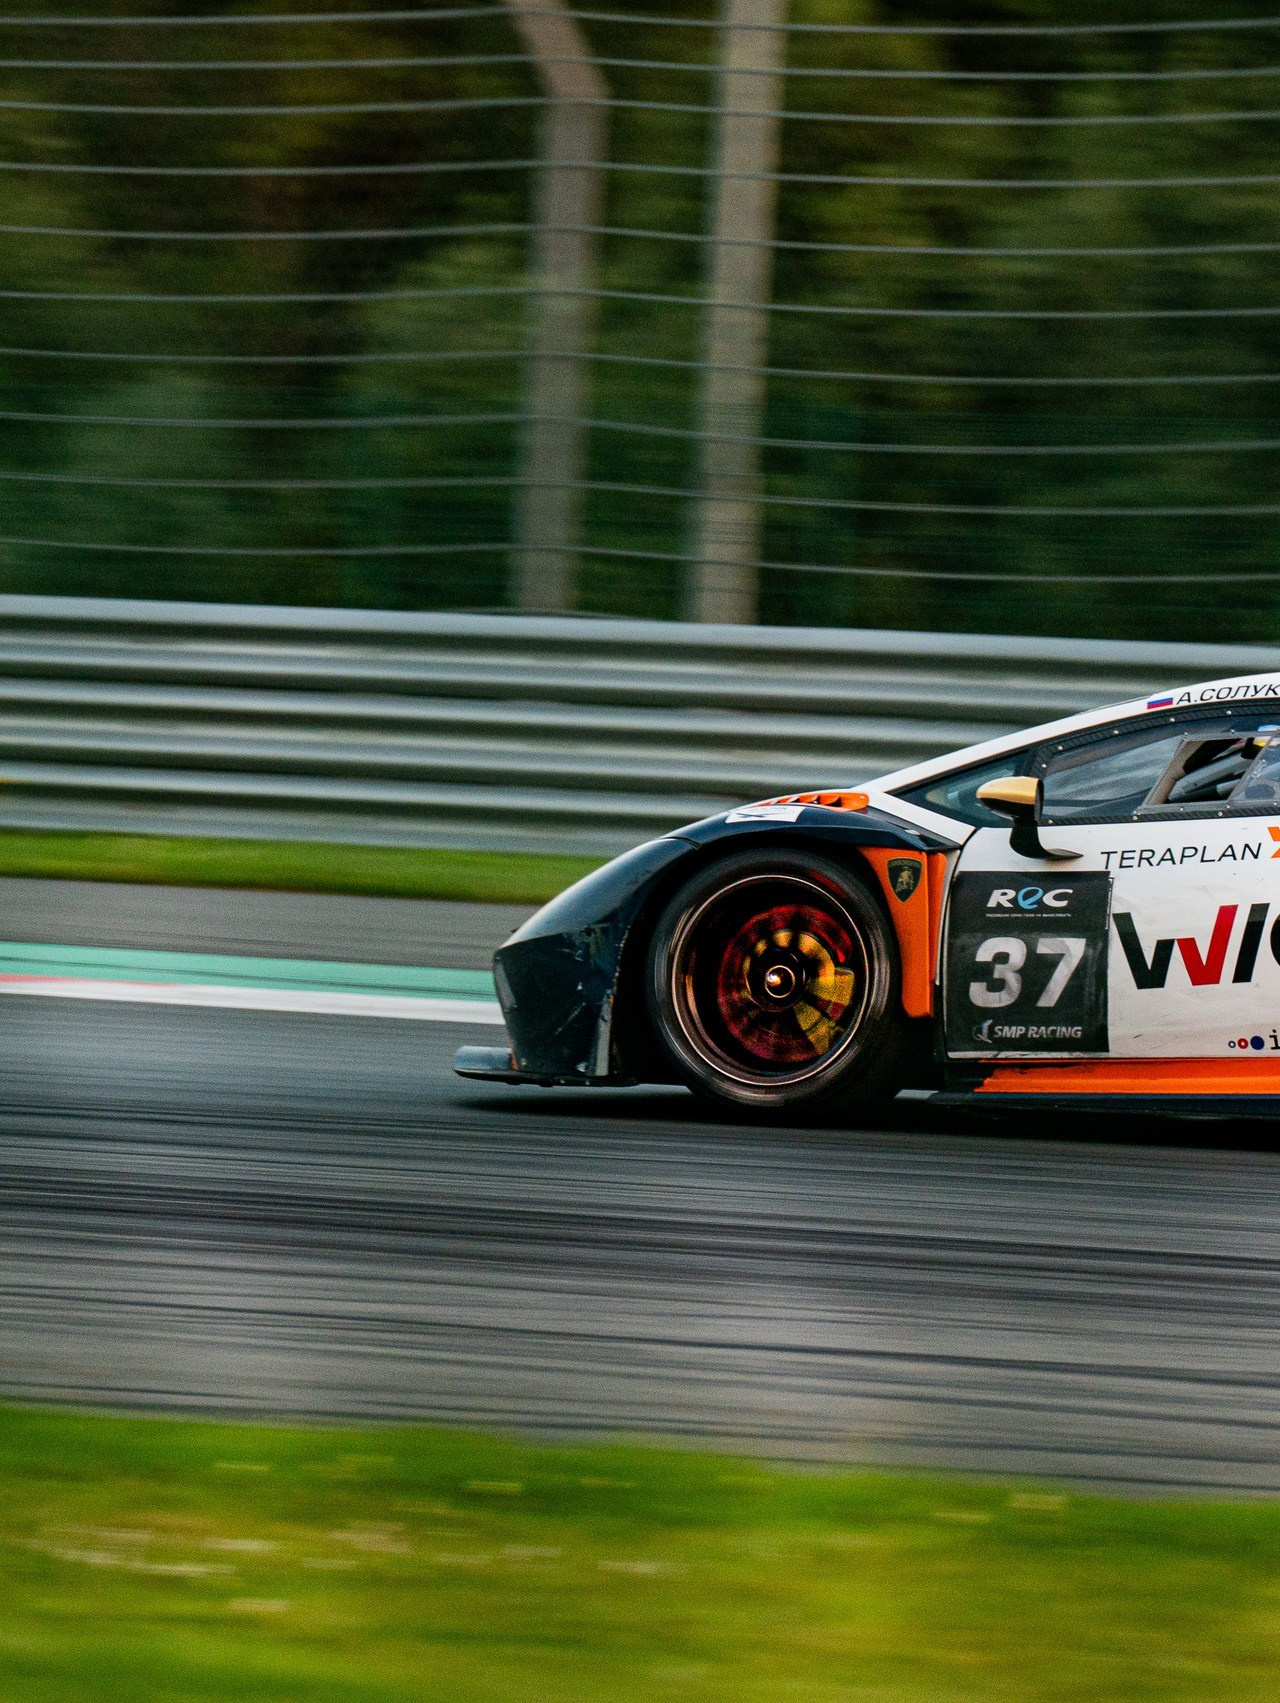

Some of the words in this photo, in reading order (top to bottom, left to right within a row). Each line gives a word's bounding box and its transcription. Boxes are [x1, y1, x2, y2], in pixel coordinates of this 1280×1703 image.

[1100, 842, 1262, 870] TERAPLAN
[968, 937, 1087, 1008] 37
[993, 1025, 1027, 1039] SMP
[1027, 1025, 1083, 1039] RACING
